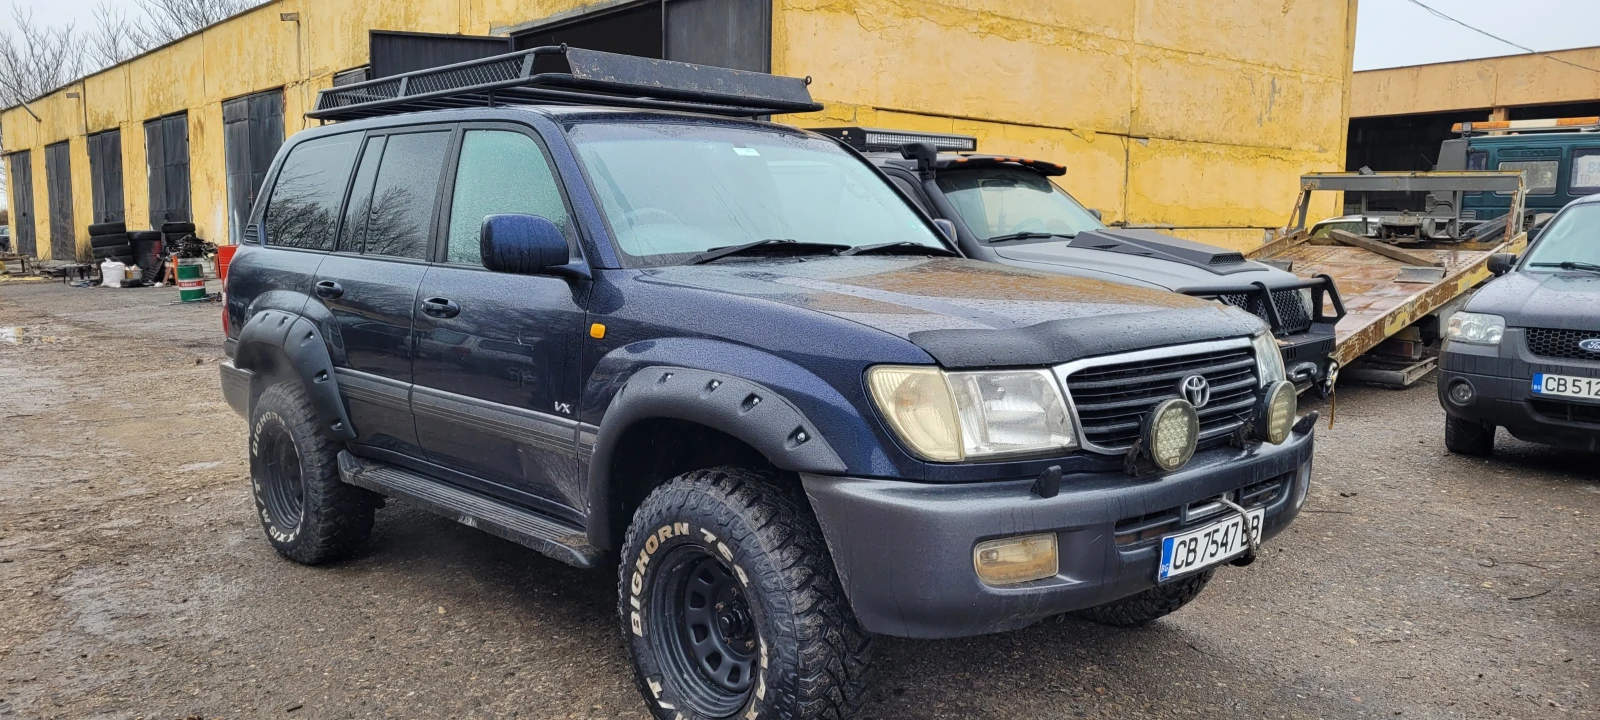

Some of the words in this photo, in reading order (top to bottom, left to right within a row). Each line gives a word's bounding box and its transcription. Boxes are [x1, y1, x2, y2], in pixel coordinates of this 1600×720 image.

[1545, 376, 1567, 392] CB
[555, 401, 570, 414] VX
[1173, 536, 1199, 570] CB
[1200, 521, 1240, 563] 7547
[630, 521, 690, 638] BIGHORN
